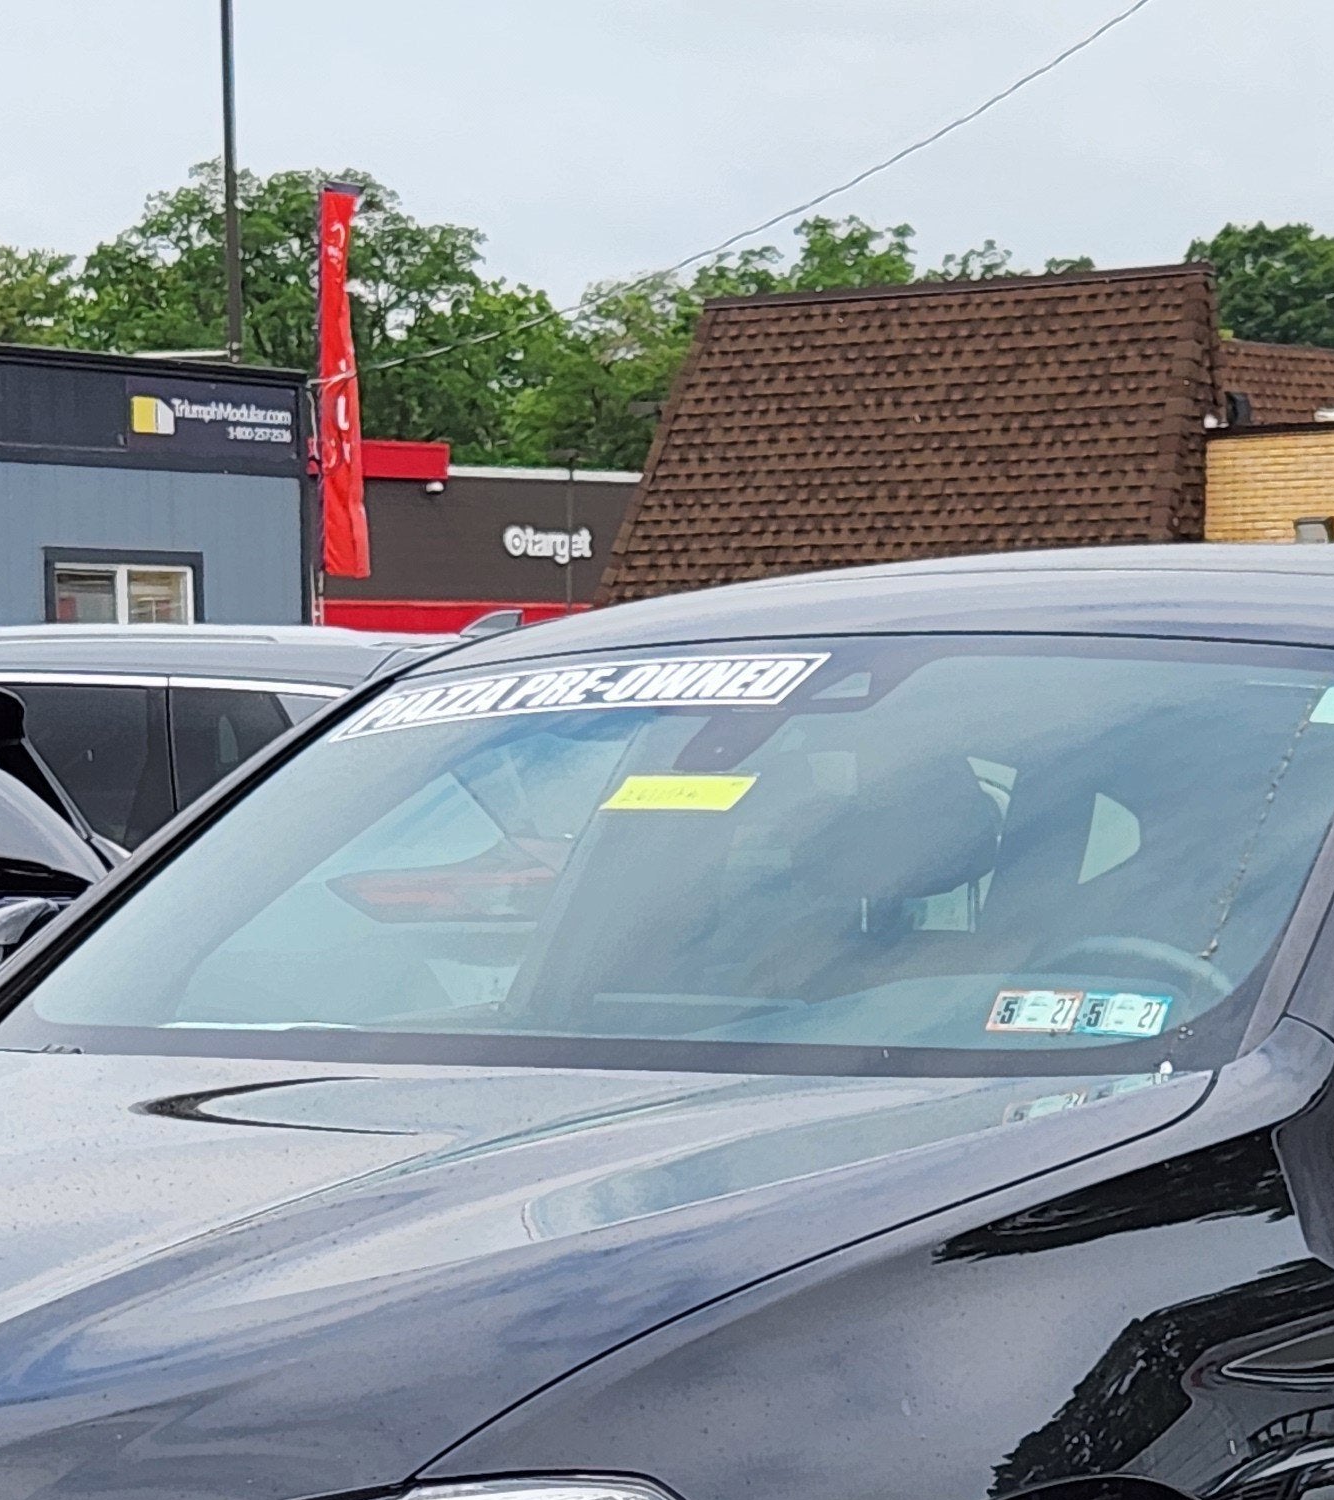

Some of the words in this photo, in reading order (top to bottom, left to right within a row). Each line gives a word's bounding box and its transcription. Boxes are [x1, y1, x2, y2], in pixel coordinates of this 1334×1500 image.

[525, 525, 592, 564] target
[347, 677, 520, 735] PIAZZA
[525, 660, 807, 707] PRE-OWNED
[1050, 998, 1077, 1025] 27
[1137, 1001, 1163, 1029] 27
